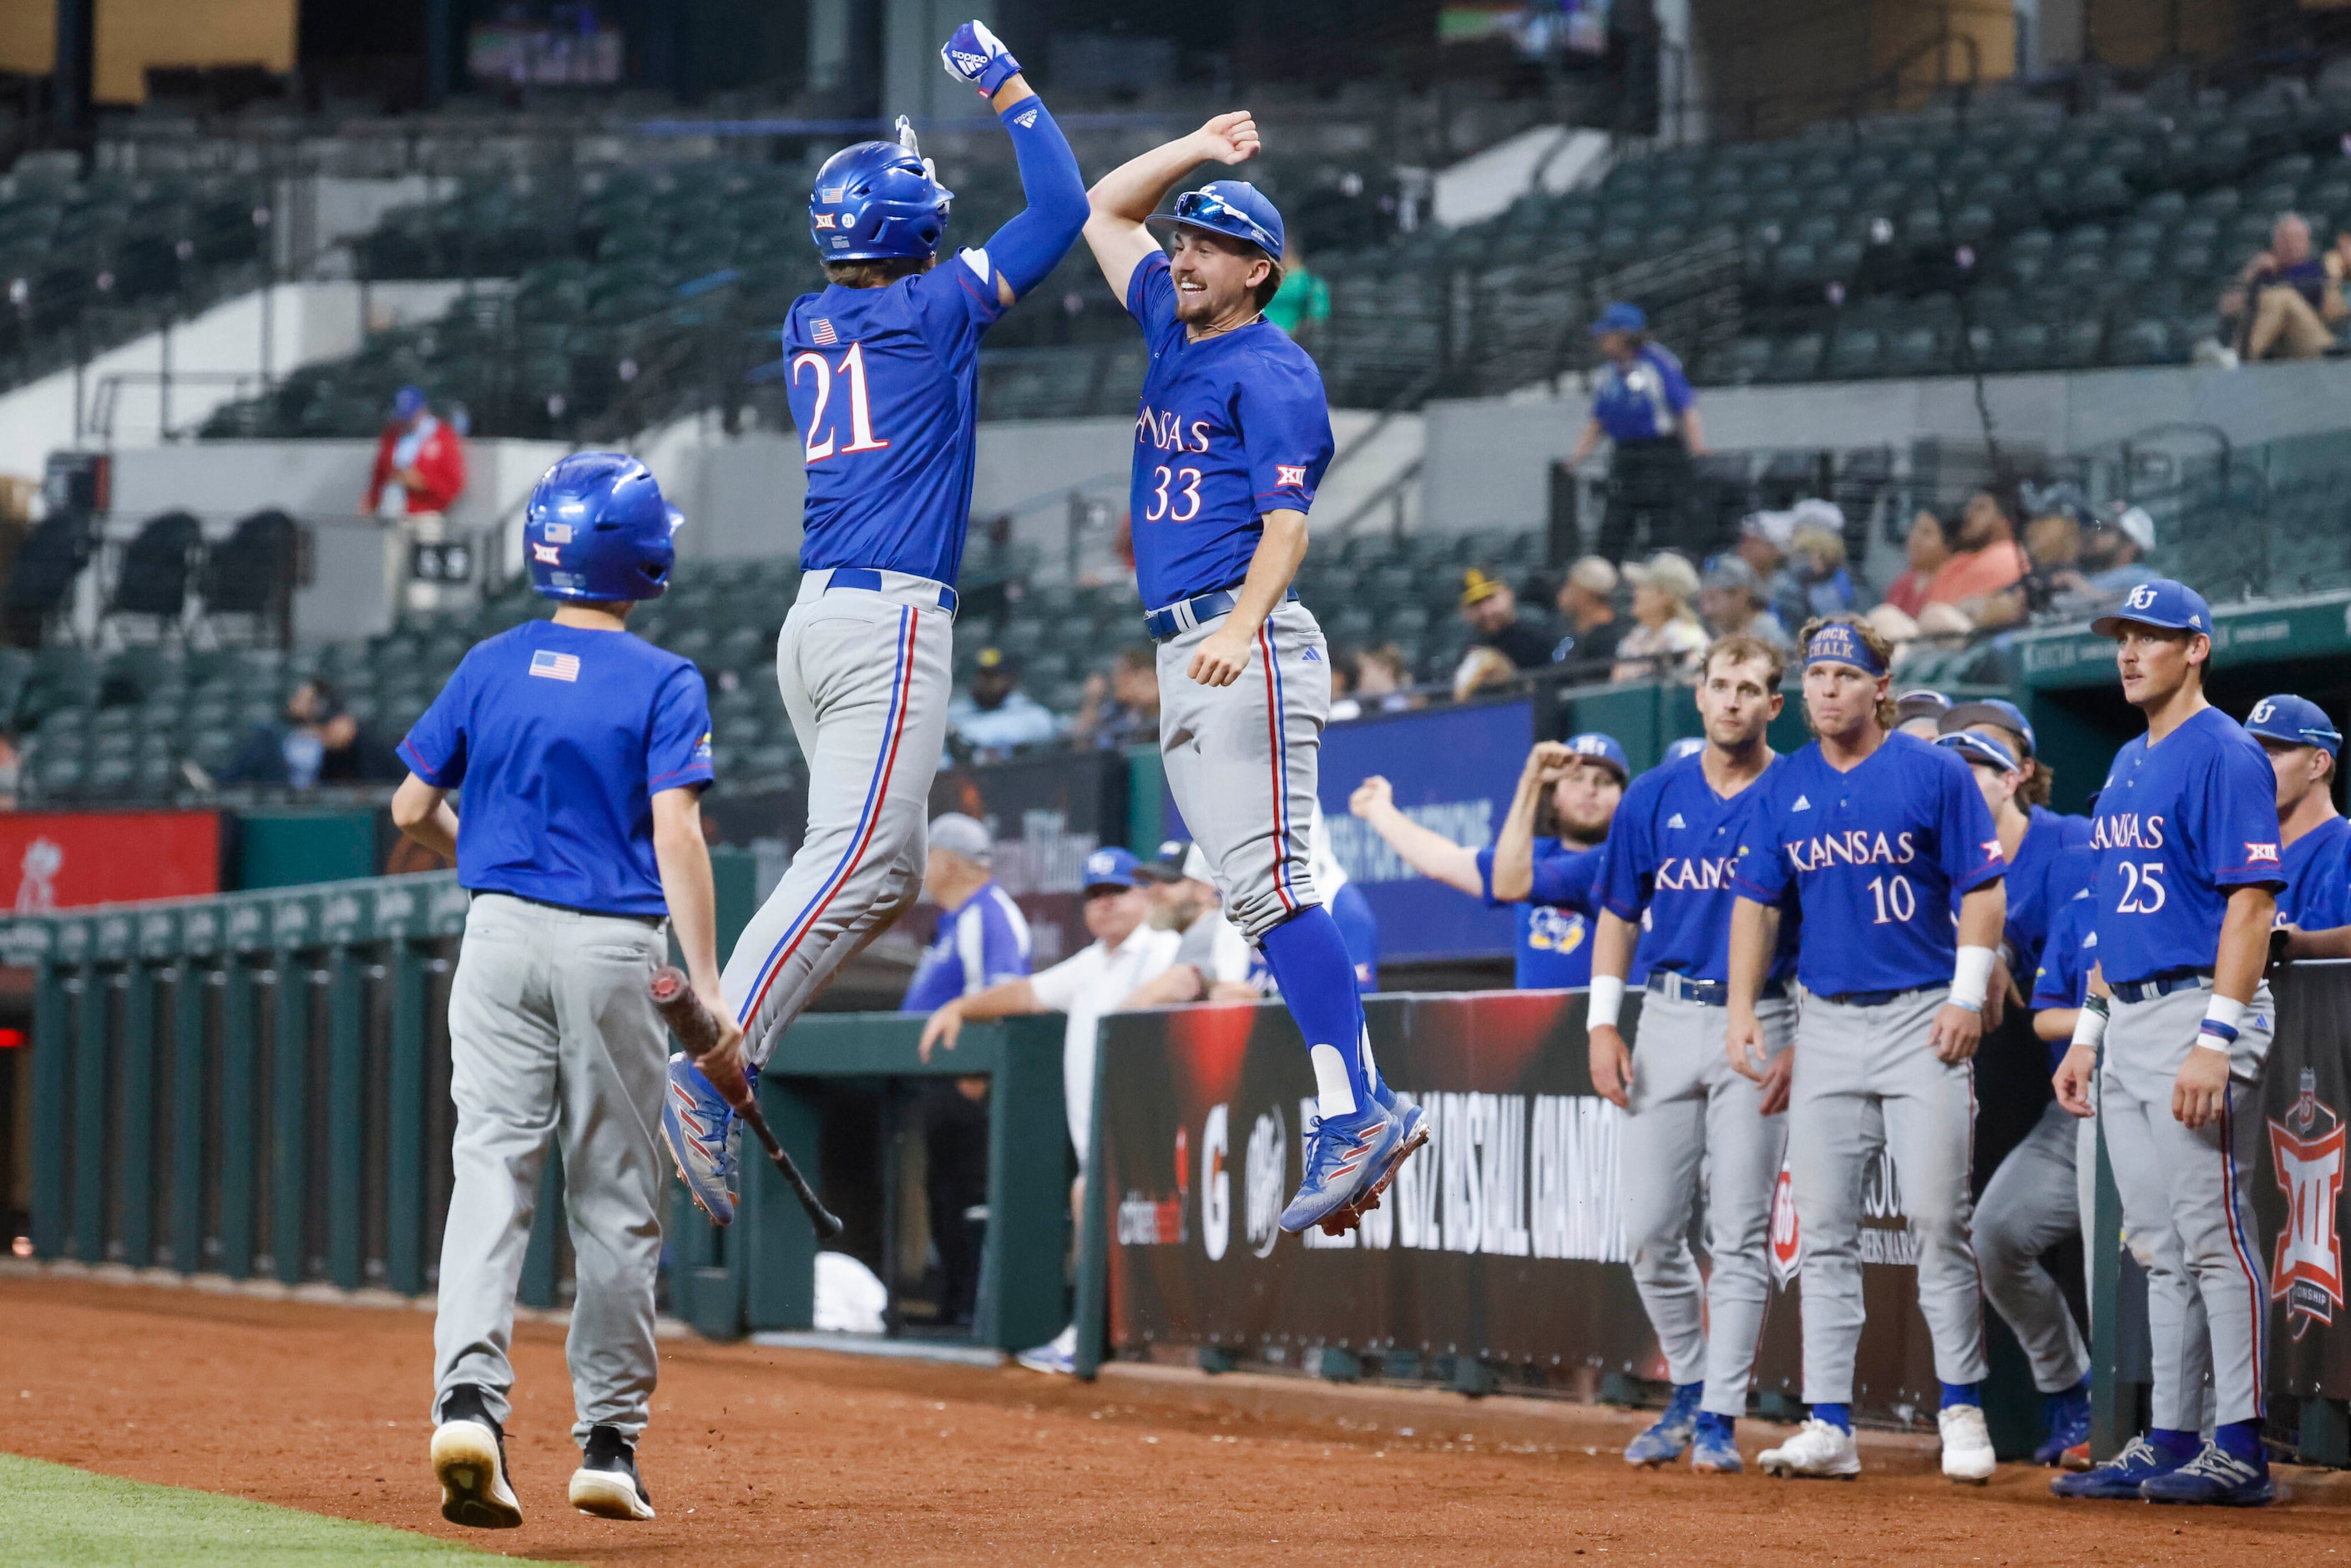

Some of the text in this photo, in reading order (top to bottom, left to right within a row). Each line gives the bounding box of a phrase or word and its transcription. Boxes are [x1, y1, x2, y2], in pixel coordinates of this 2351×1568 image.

[951, 49, 988, 64] adidas
[1013, 109, 1038, 125] adidas
[792, 340, 891, 465] 21
[1145, 463, 1202, 523] 33
[1276, 464, 1307, 488] XII
[1808, 641, 1854, 659] CHALK
[1785, 830, 1915, 872] KANSAS
[1867, 874, 1916, 924] 10
[2116, 861, 2166, 914] 25
